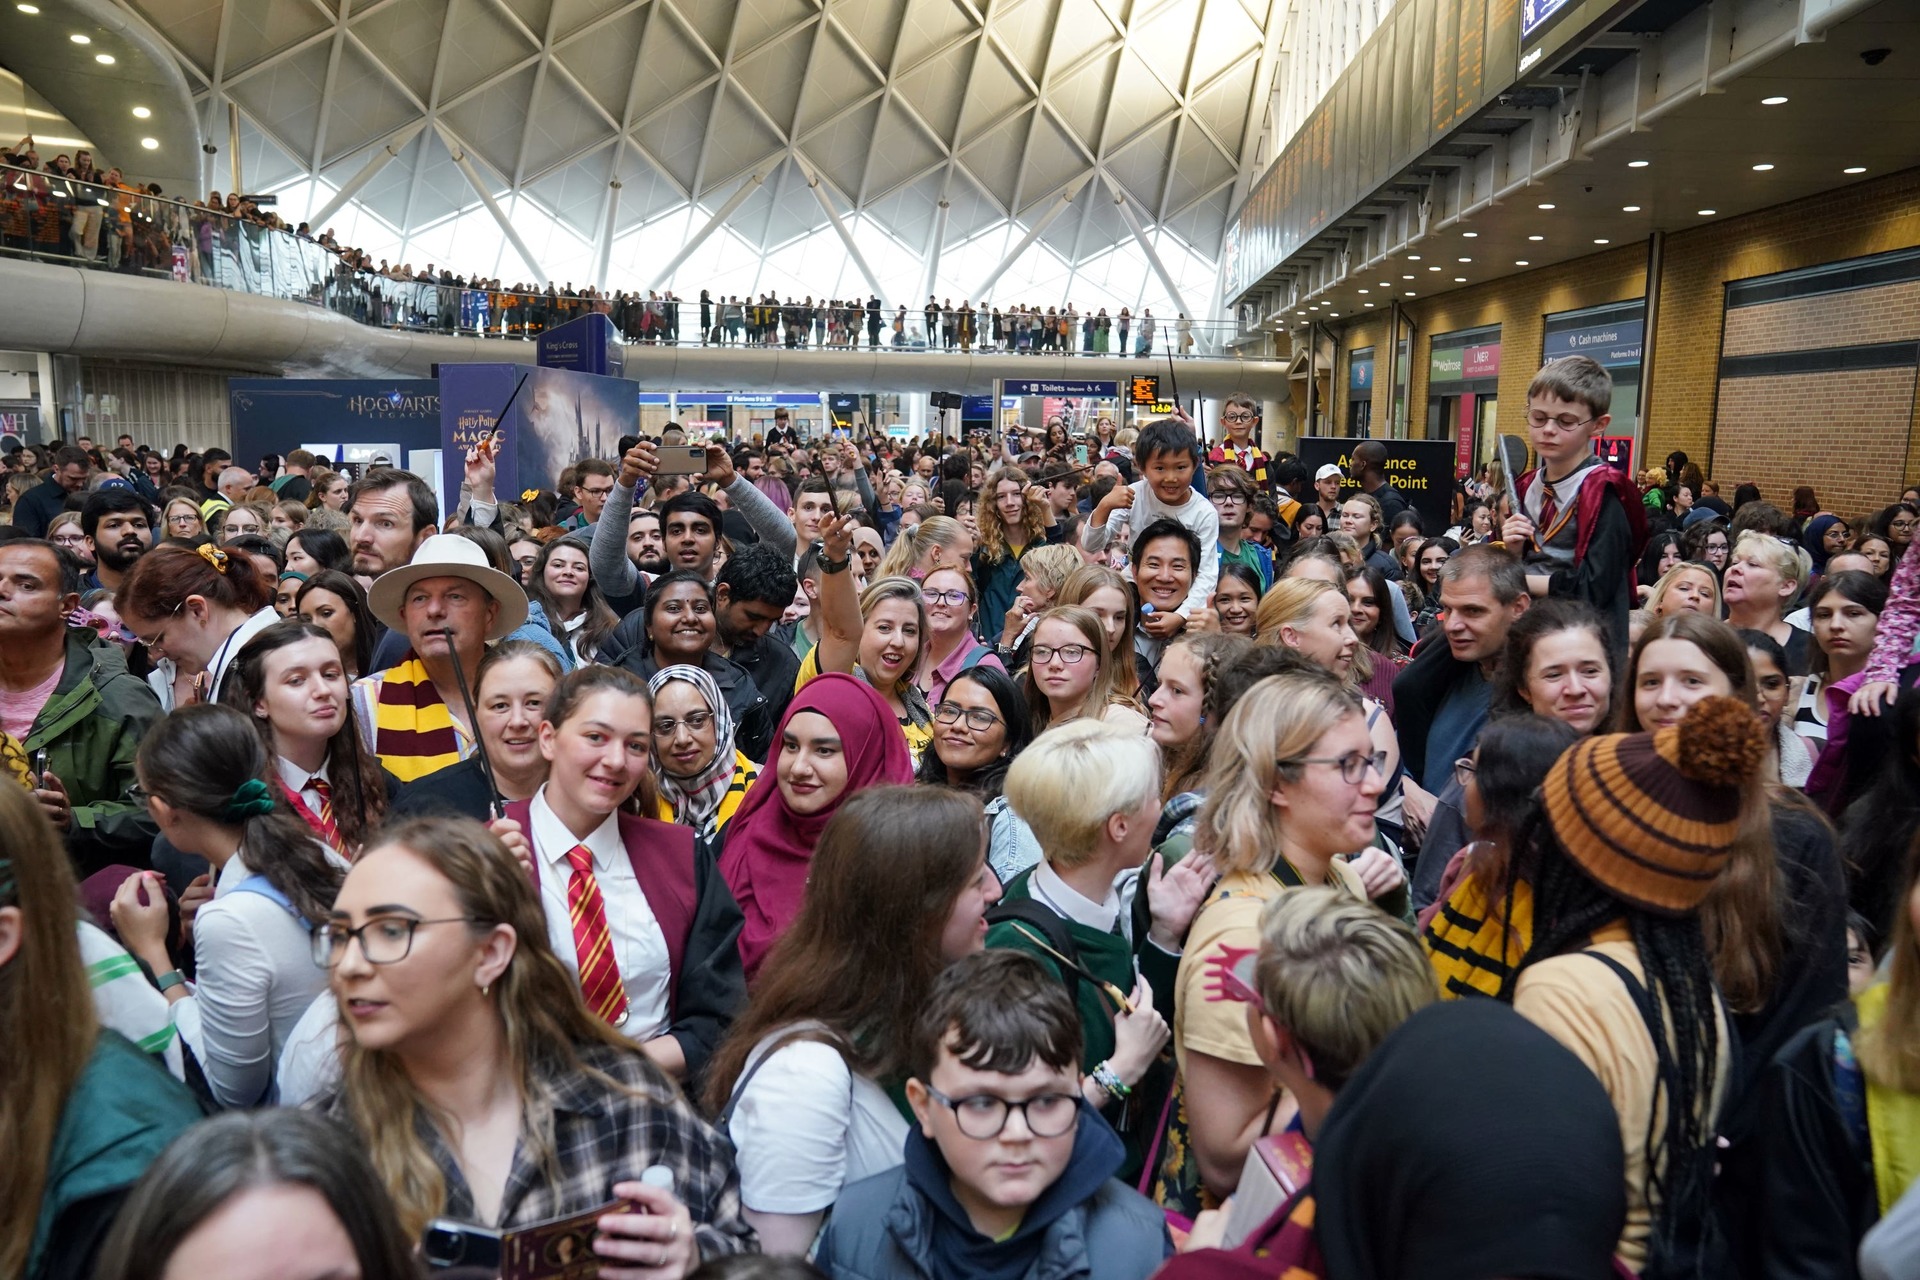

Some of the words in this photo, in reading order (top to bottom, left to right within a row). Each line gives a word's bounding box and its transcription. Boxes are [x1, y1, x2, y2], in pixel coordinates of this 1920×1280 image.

[1578, 333, 1592, 345] Cash
[1592, 331, 1618, 344] machines
[546, 341, 561, 351] King's
[562, 340, 578, 350] Cross
[1473, 351, 1489, 364] LNER
[1439, 359, 1461, 372] Waitrose
[1041, 383, 1065, 392] Toilets
[458, 416, 478, 430] Harry
[453, 429, 506, 442] MAGC
[1338, 454, 1417, 470] Asance
[1390, 474, 1428, 489] Point
